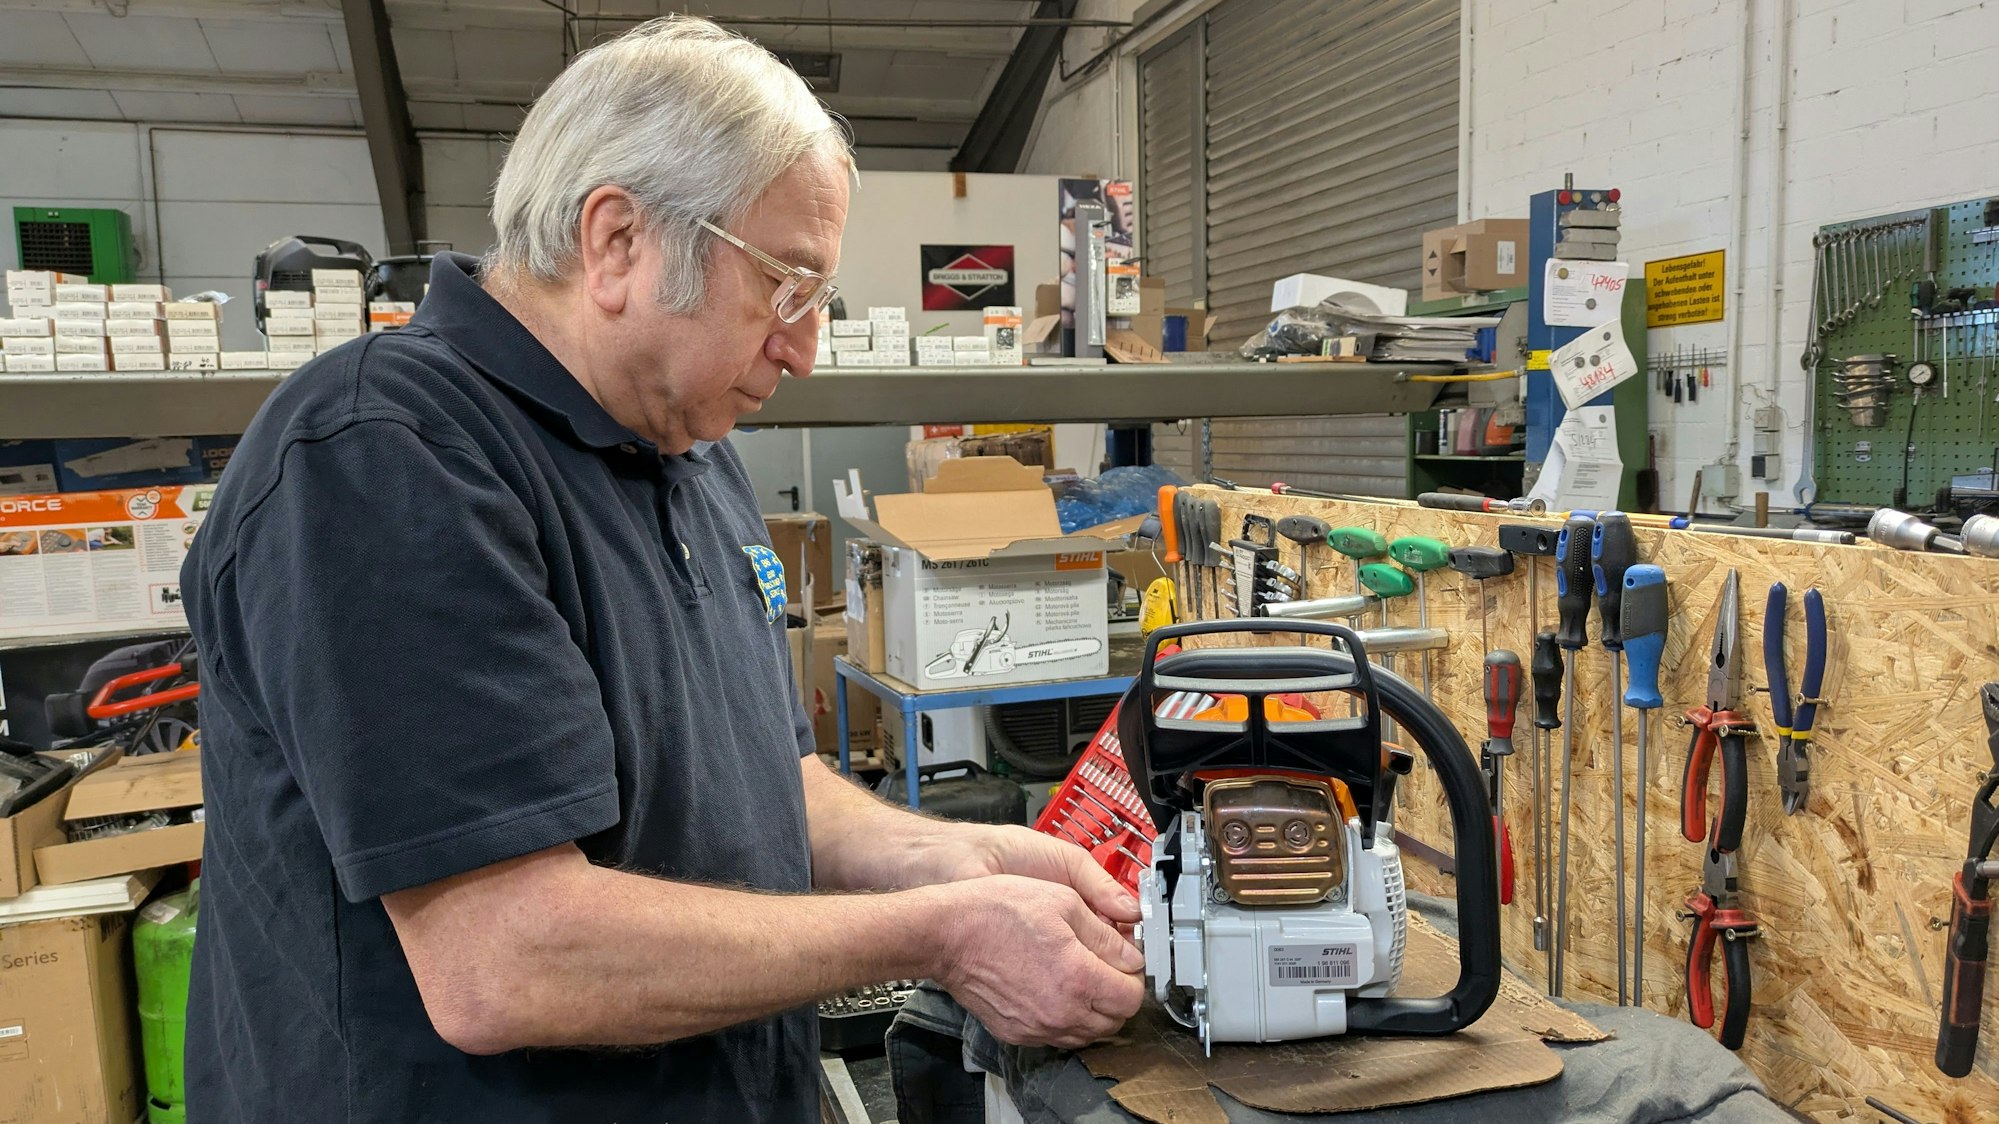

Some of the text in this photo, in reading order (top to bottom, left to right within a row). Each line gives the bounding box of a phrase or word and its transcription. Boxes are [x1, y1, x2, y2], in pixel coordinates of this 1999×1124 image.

[1661, 258, 1706, 274] Lebensgefahr!
[967, 273, 1003, 281] STRATTON
[1653, 271, 1715, 287] Der Aufenthalt unter
[1654, 283, 1713, 299] schwebenden oder
[1689, 296, 1710, 306] Lasten
[1711, 294, 1720, 303] ist
[1657, 307, 1708, 322] streng verboten!
[1059, 551, 1099, 563] STIHL
[921, 559, 938, 570] MS
[941, 559, 957, 569] 261
[1027, 649, 1053, 659] STIHL
[1321, 947, 1353, 956] STIHL
[2, 950, 59, 970] Series
